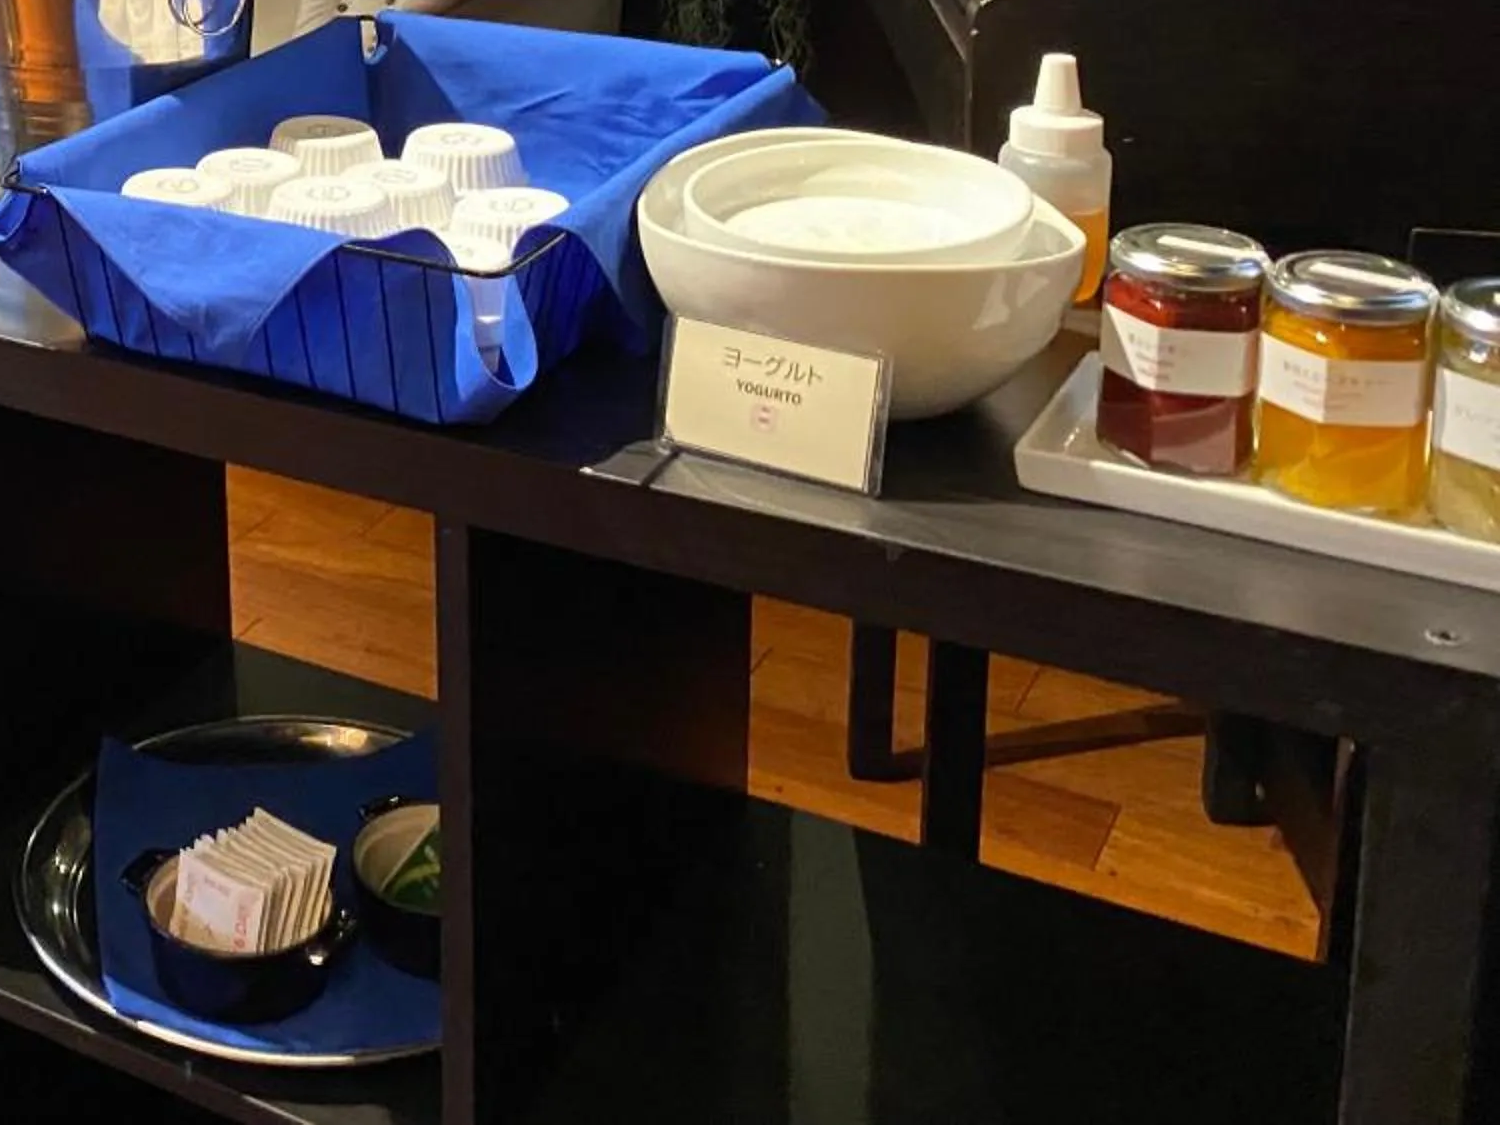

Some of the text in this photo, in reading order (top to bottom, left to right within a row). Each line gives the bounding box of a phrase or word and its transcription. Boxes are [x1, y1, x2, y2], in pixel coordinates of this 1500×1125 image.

[722, 346, 824, 386] ヨーグルト
